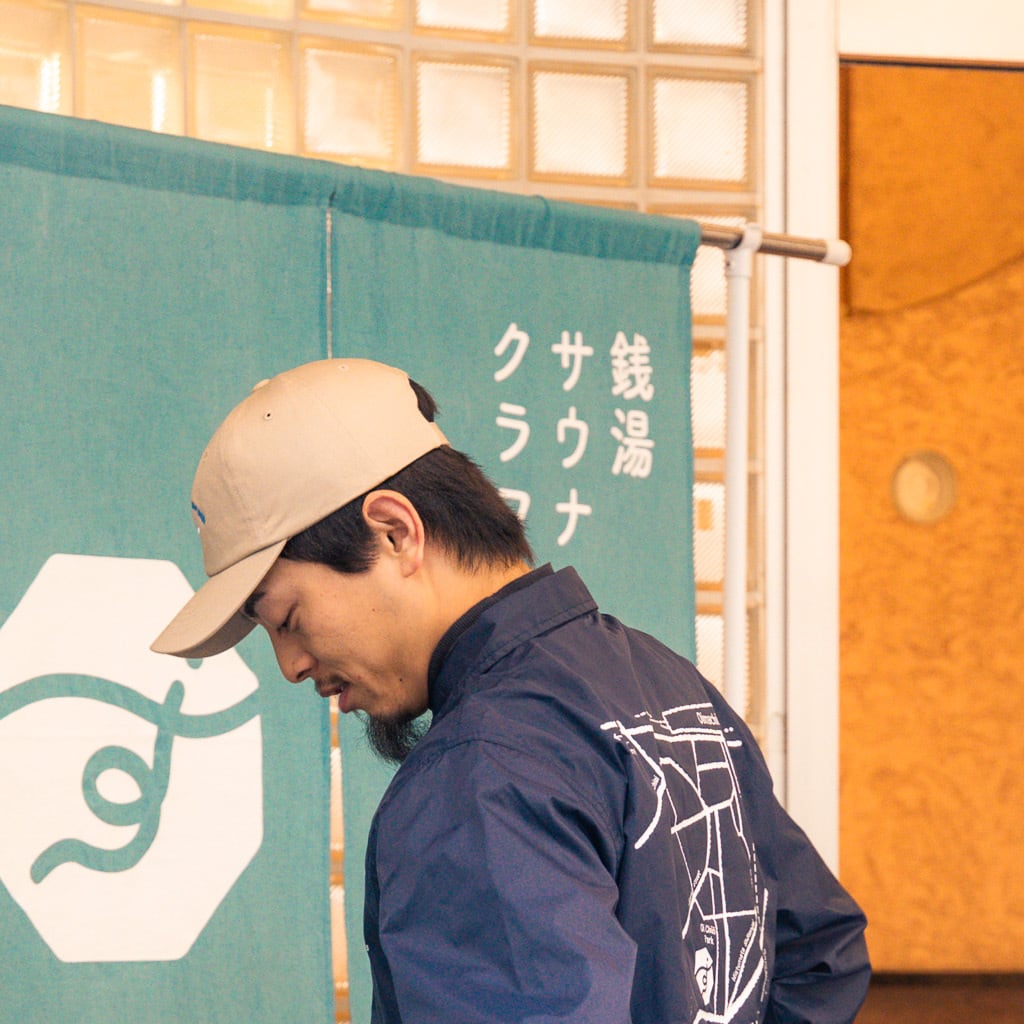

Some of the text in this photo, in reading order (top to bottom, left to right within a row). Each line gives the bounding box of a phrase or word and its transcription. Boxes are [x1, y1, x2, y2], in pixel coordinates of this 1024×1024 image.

[551, 330, 594, 546] サウナ
[609, 330, 655, 479] 銭湯
